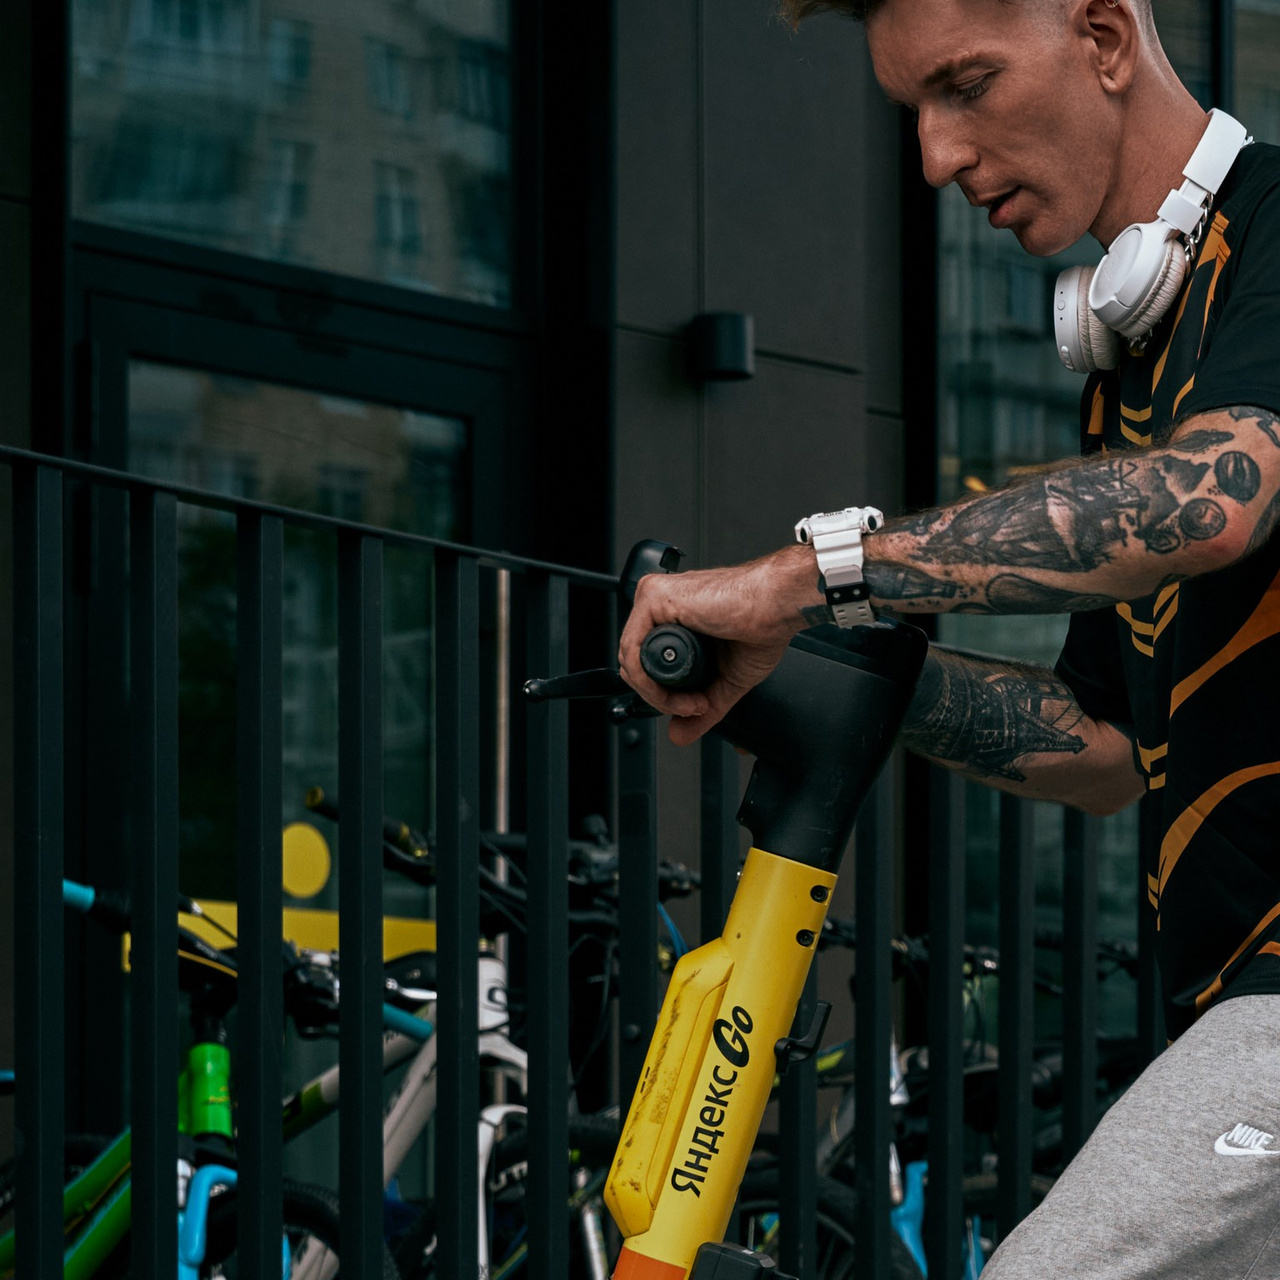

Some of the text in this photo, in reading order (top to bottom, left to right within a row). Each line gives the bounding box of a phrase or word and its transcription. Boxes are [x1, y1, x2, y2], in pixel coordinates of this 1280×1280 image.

[671, 1005, 754, 1198] Яндекс Go
[1227, 1123, 1274, 1149] NIKE
